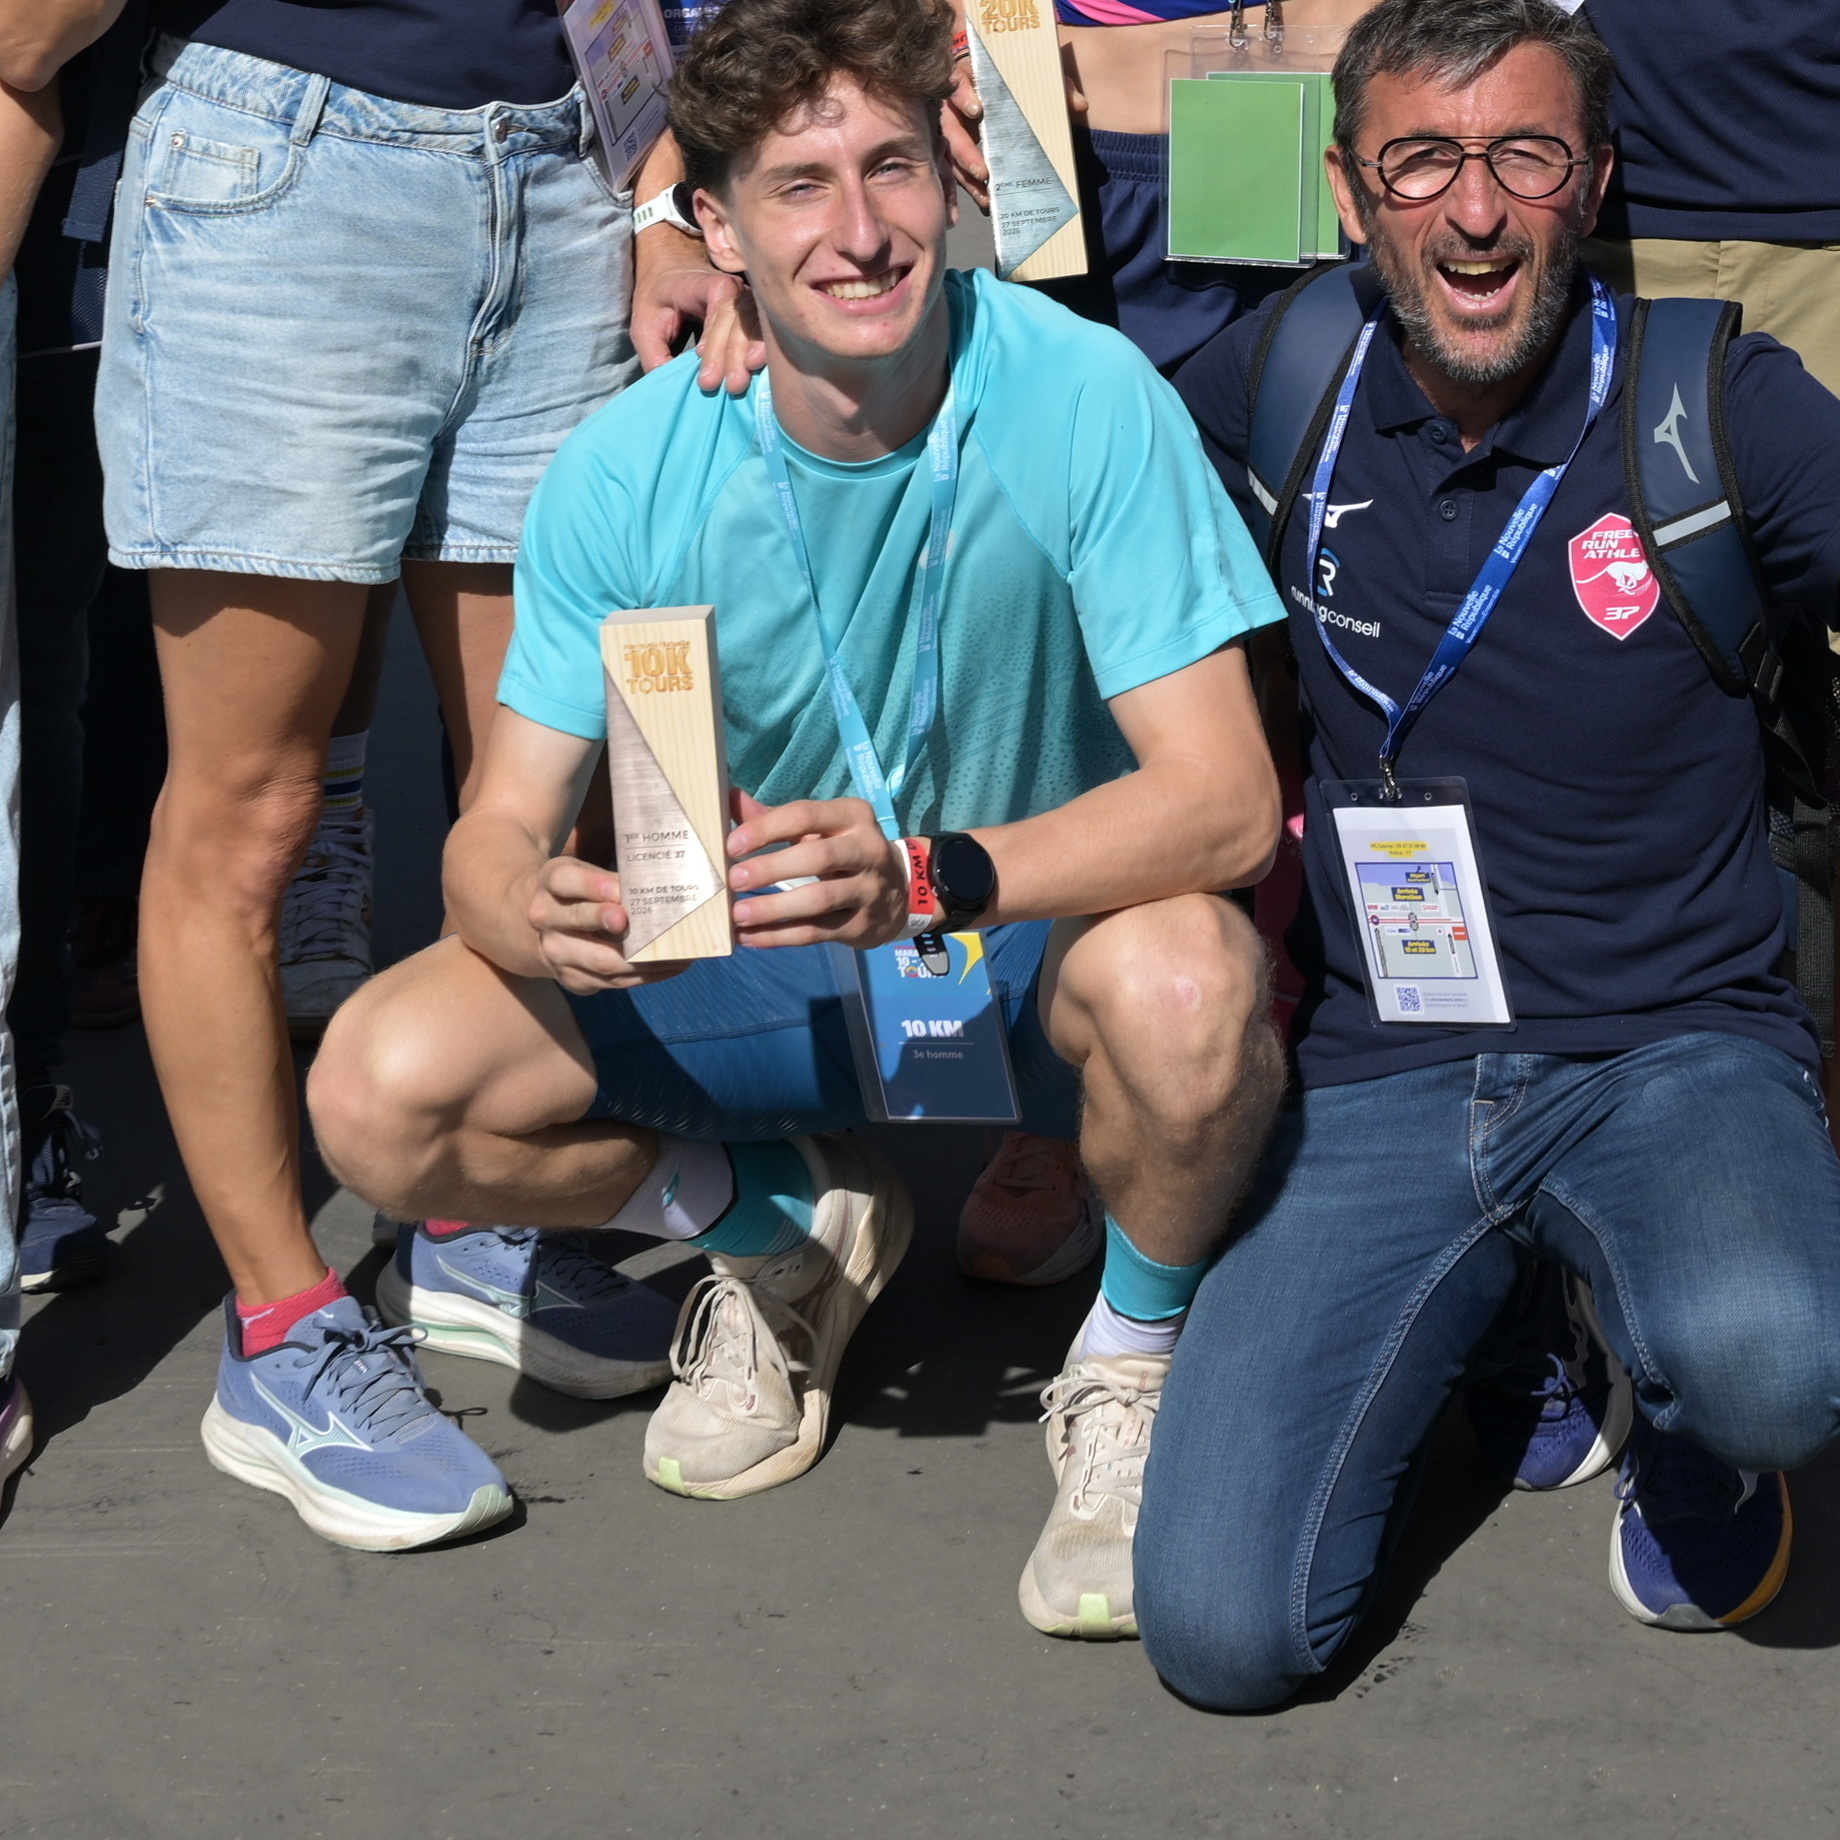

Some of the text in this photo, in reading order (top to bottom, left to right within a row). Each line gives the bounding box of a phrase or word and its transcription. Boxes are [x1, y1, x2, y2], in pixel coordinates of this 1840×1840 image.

[982, 14, 1040, 34] TOURS
[1016, 177, 1052, 188] FEMME
[1036, 207, 1060, 215] TOURS
[1012, 216, 1057, 227] SEPTEMBRE
[1506, 503, 1537, 550] République
[1592, 529, 1633, 540] FREE
[1581, 539, 1618, 549] RUN
[1583, 548, 1640, 559] ATHLE
[1460, 584, 1492, 632] République
[1604, 606, 1640, 620] 37
[624, 647, 692, 678] 10K
[626, 674, 694, 694] TOURS
[643, 830, 689, 841] HOMME
[627, 850, 685, 862] LICENCIÉ 37
[913, 855, 925, 880] KM
[643, 895, 696, 905] SEPTEMBRE
[917, 886, 927, 905] 10
[896, 956, 908, 967] 10
[901, 1020, 964, 1037] 10 KM
[913, 1049, 963, 1059] 3e homme
